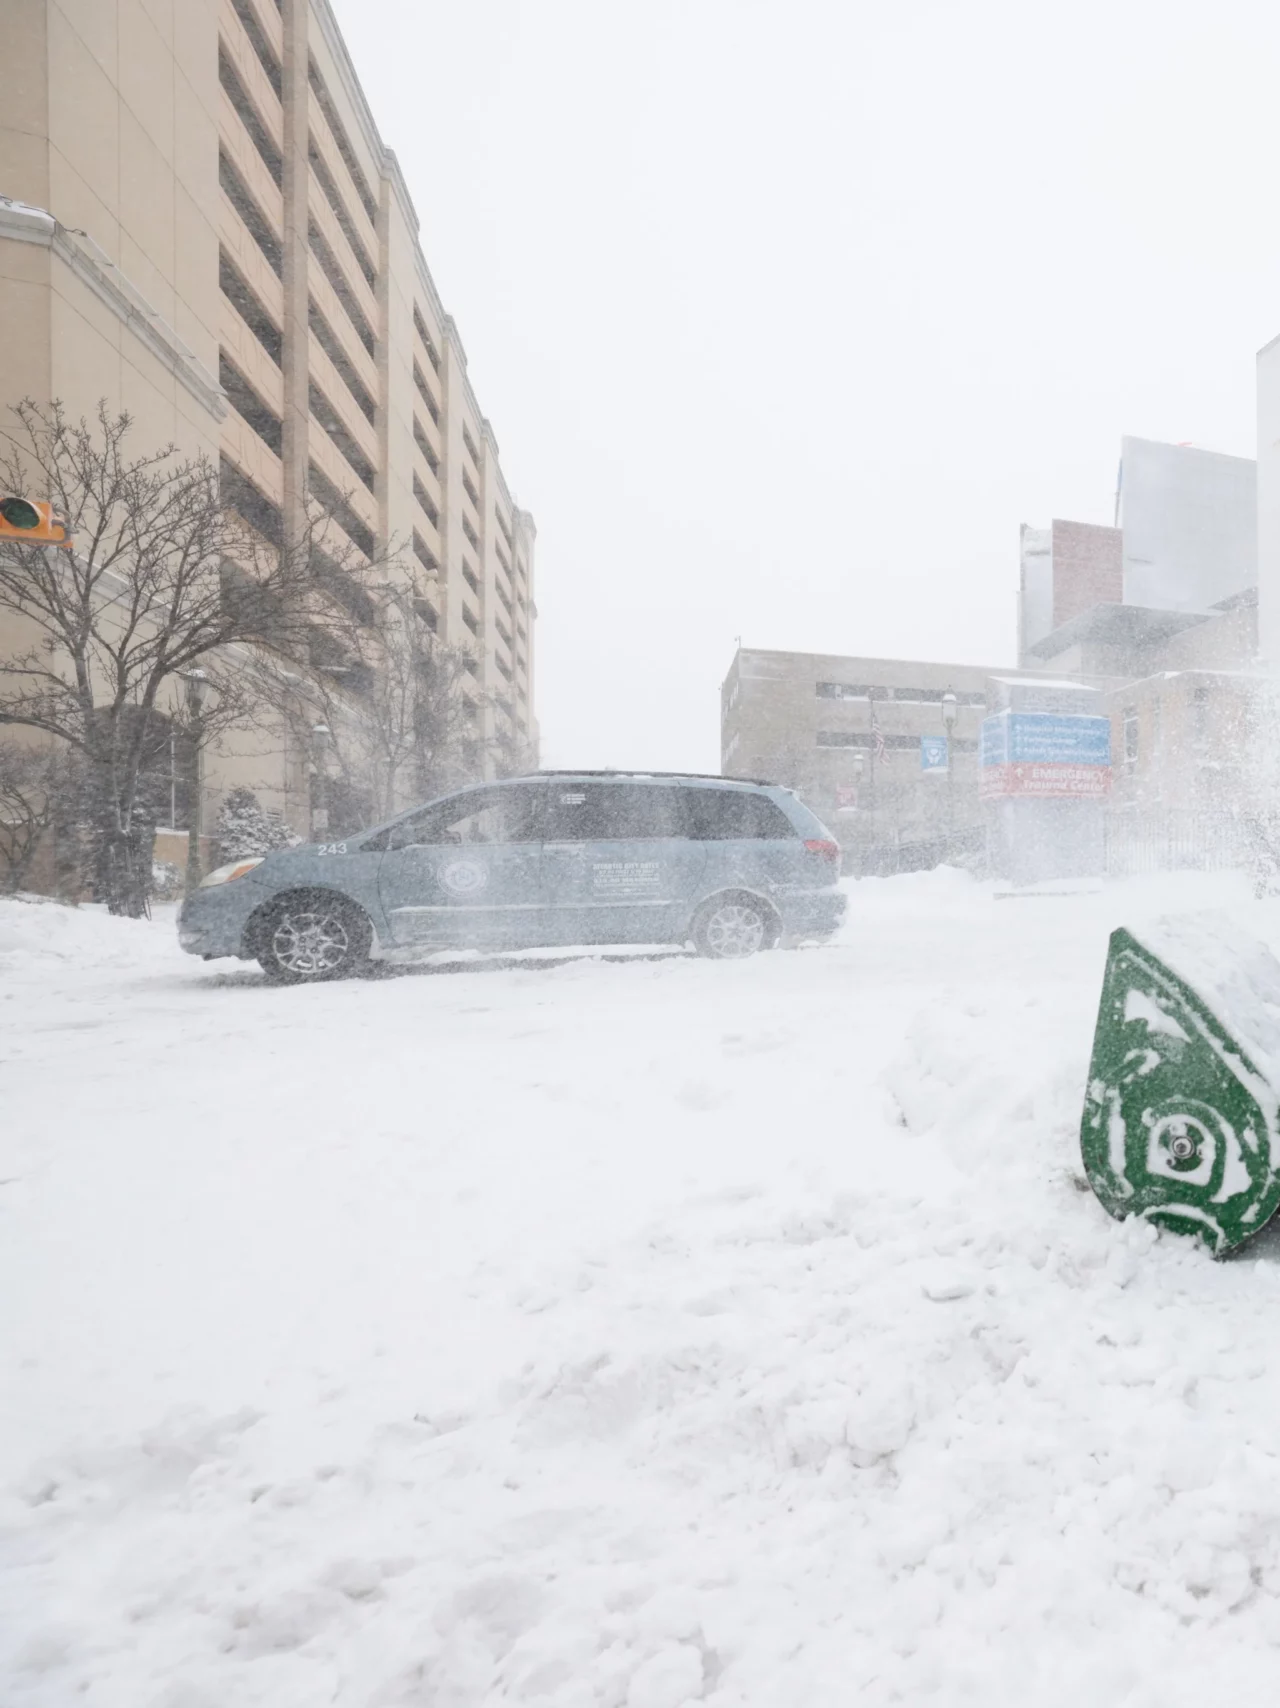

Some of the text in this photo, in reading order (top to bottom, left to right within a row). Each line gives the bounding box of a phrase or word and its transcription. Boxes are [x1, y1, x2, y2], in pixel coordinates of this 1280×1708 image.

[1032, 768, 1105, 781] EMERGENCY
[1023, 779, 1105, 791] Trauma Center
[317, 842, 348, 856] 243
